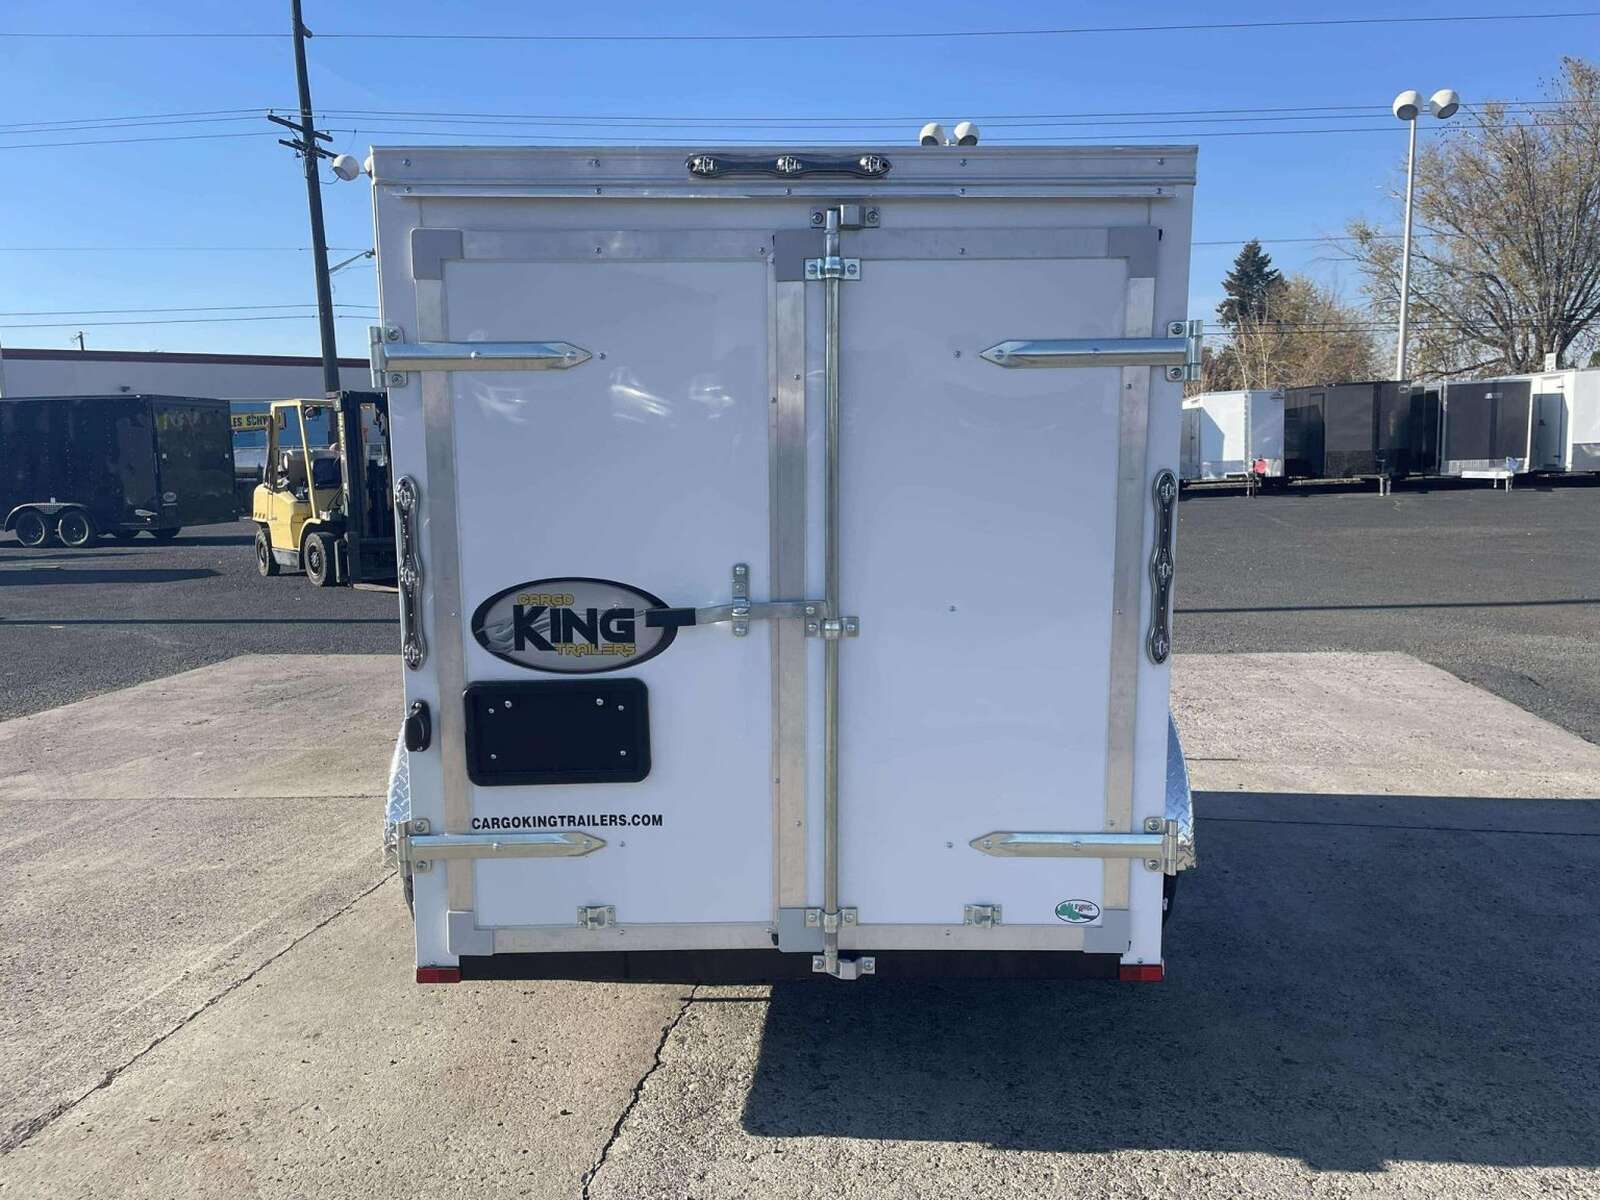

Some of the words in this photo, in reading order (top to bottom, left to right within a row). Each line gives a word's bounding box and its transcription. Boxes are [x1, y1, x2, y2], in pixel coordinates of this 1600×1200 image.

[518, 594, 575, 607] CARGO
[513, 605, 635, 651] KING
[554, 643, 636, 657] TRAILERS
[471, 814, 663, 829] CARGOKINGTRAILERS.COM
